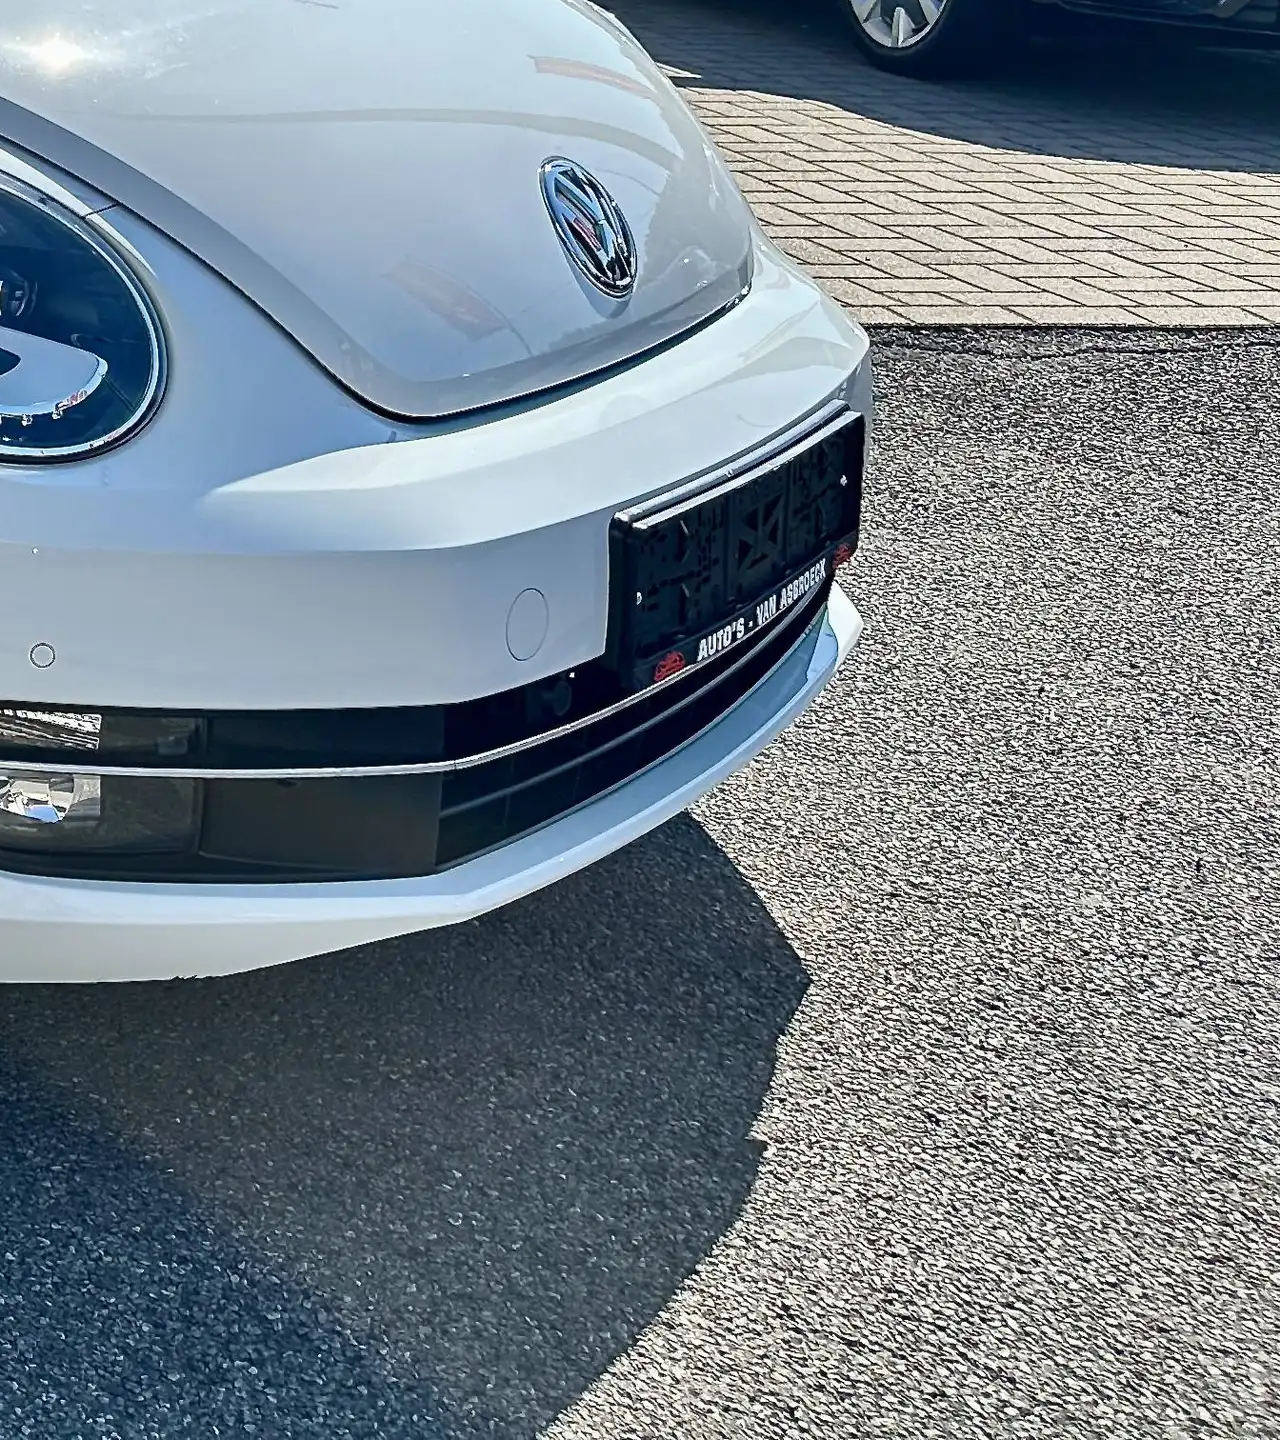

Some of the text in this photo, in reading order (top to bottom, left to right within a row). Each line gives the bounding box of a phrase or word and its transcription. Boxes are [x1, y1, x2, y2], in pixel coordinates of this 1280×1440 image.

[696, 617, 745, 662] AUTO'S
[755, 594, 777, 626] VAN
[779, 558, 826, 610] ASBROECK
